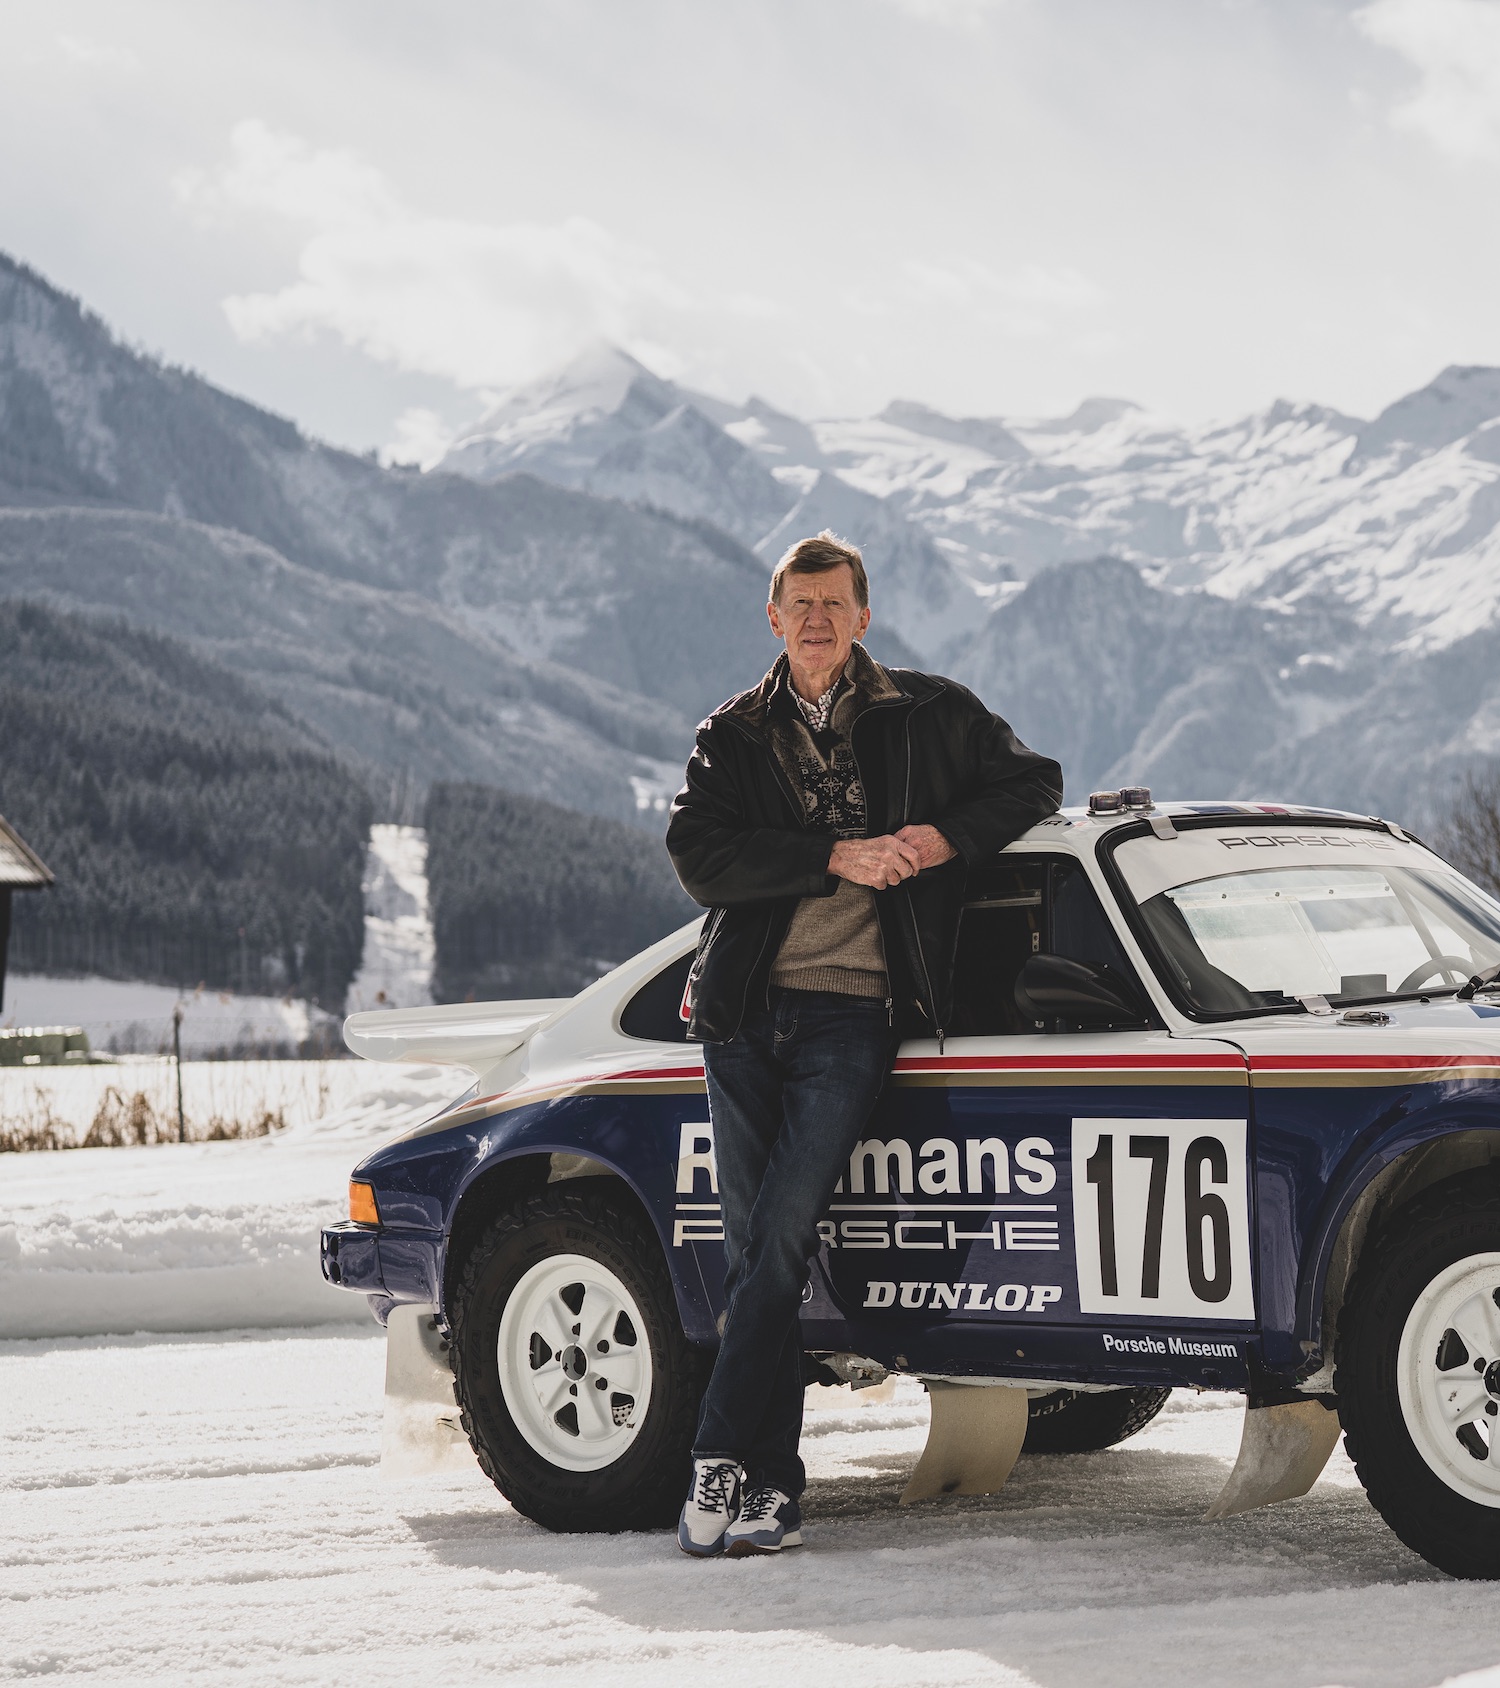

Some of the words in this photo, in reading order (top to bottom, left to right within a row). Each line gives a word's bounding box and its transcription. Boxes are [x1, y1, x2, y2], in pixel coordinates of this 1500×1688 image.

[1216, 834, 1396, 851] PORSCHE
[675, 1122, 1058, 1196] Rmans
[1086, 1133, 1232, 1304] 176
[672, 1219, 1060, 1251] PRSCHE
[862, 1281, 1063, 1313] DUNLOP
[1102, 1333, 1167, 1355] Porsche
[1167, 1336, 1239, 1358] Museum
